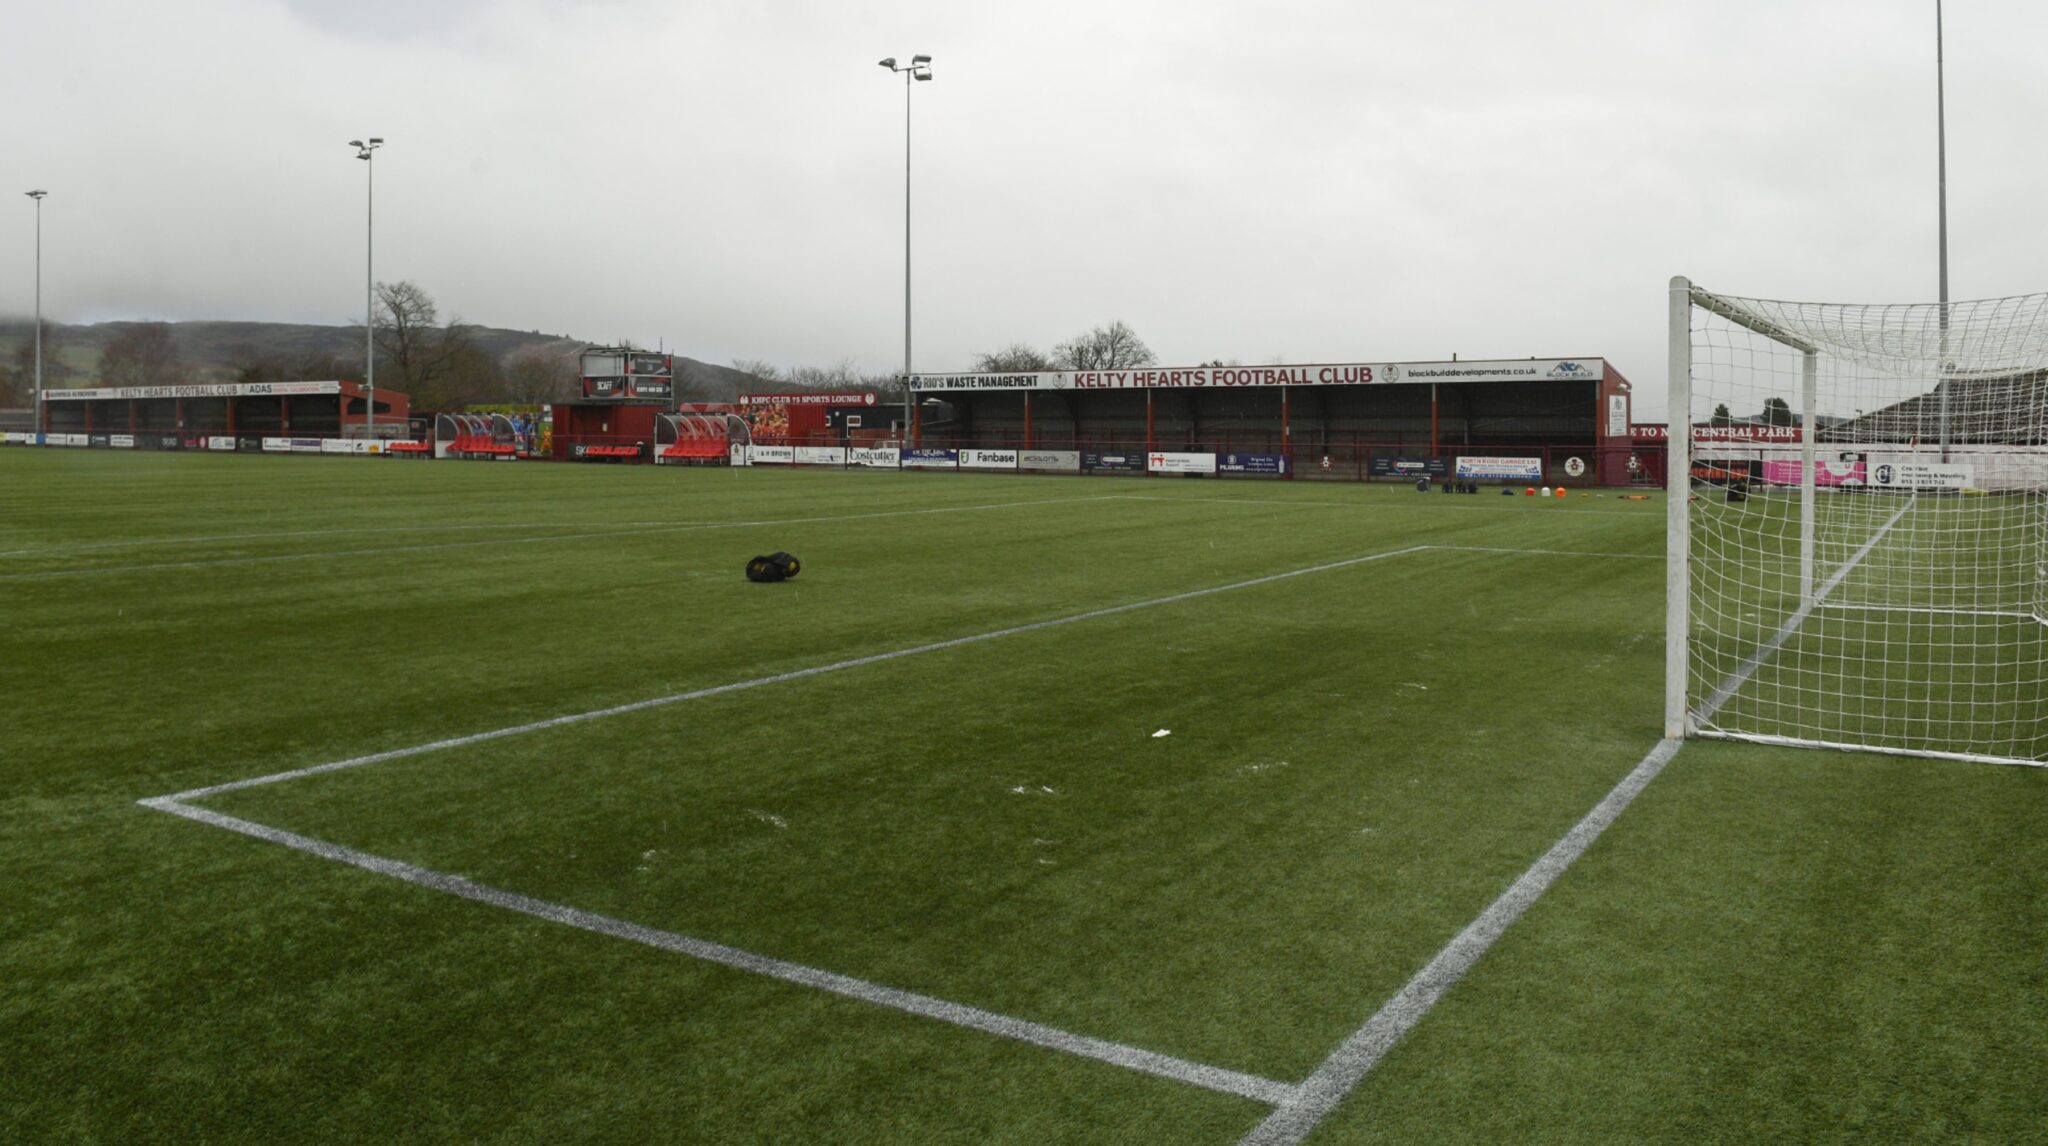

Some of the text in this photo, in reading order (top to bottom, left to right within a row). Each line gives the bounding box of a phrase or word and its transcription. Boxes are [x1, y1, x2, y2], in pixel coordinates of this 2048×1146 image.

[1074, 367, 1373, 388] KELTY HEARTS FOOTBALL CLUB
[1408, 368, 1537, 378] blockbuilddevelopments.co.uk
[923, 375, 1038, 388] RIO'S WASTE MANAGEMENT
[144, 387, 173, 397] HEARTS
[175, 385, 215, 397] FOOTBALL
[217, 384, 238, 395] CLUB
[249, 384, 272, 394] ADAS
[772, 396, 791, 404] CLUB
[831, 395, 862, 403] LOUNGE
[1640, 427, 1657, 437] TO
[1692, 427, 1796, 437] CENTRAL PARK
[849, 449, 896, 461] Costcutter
[977, 452, 1015, 463] Fanbase
